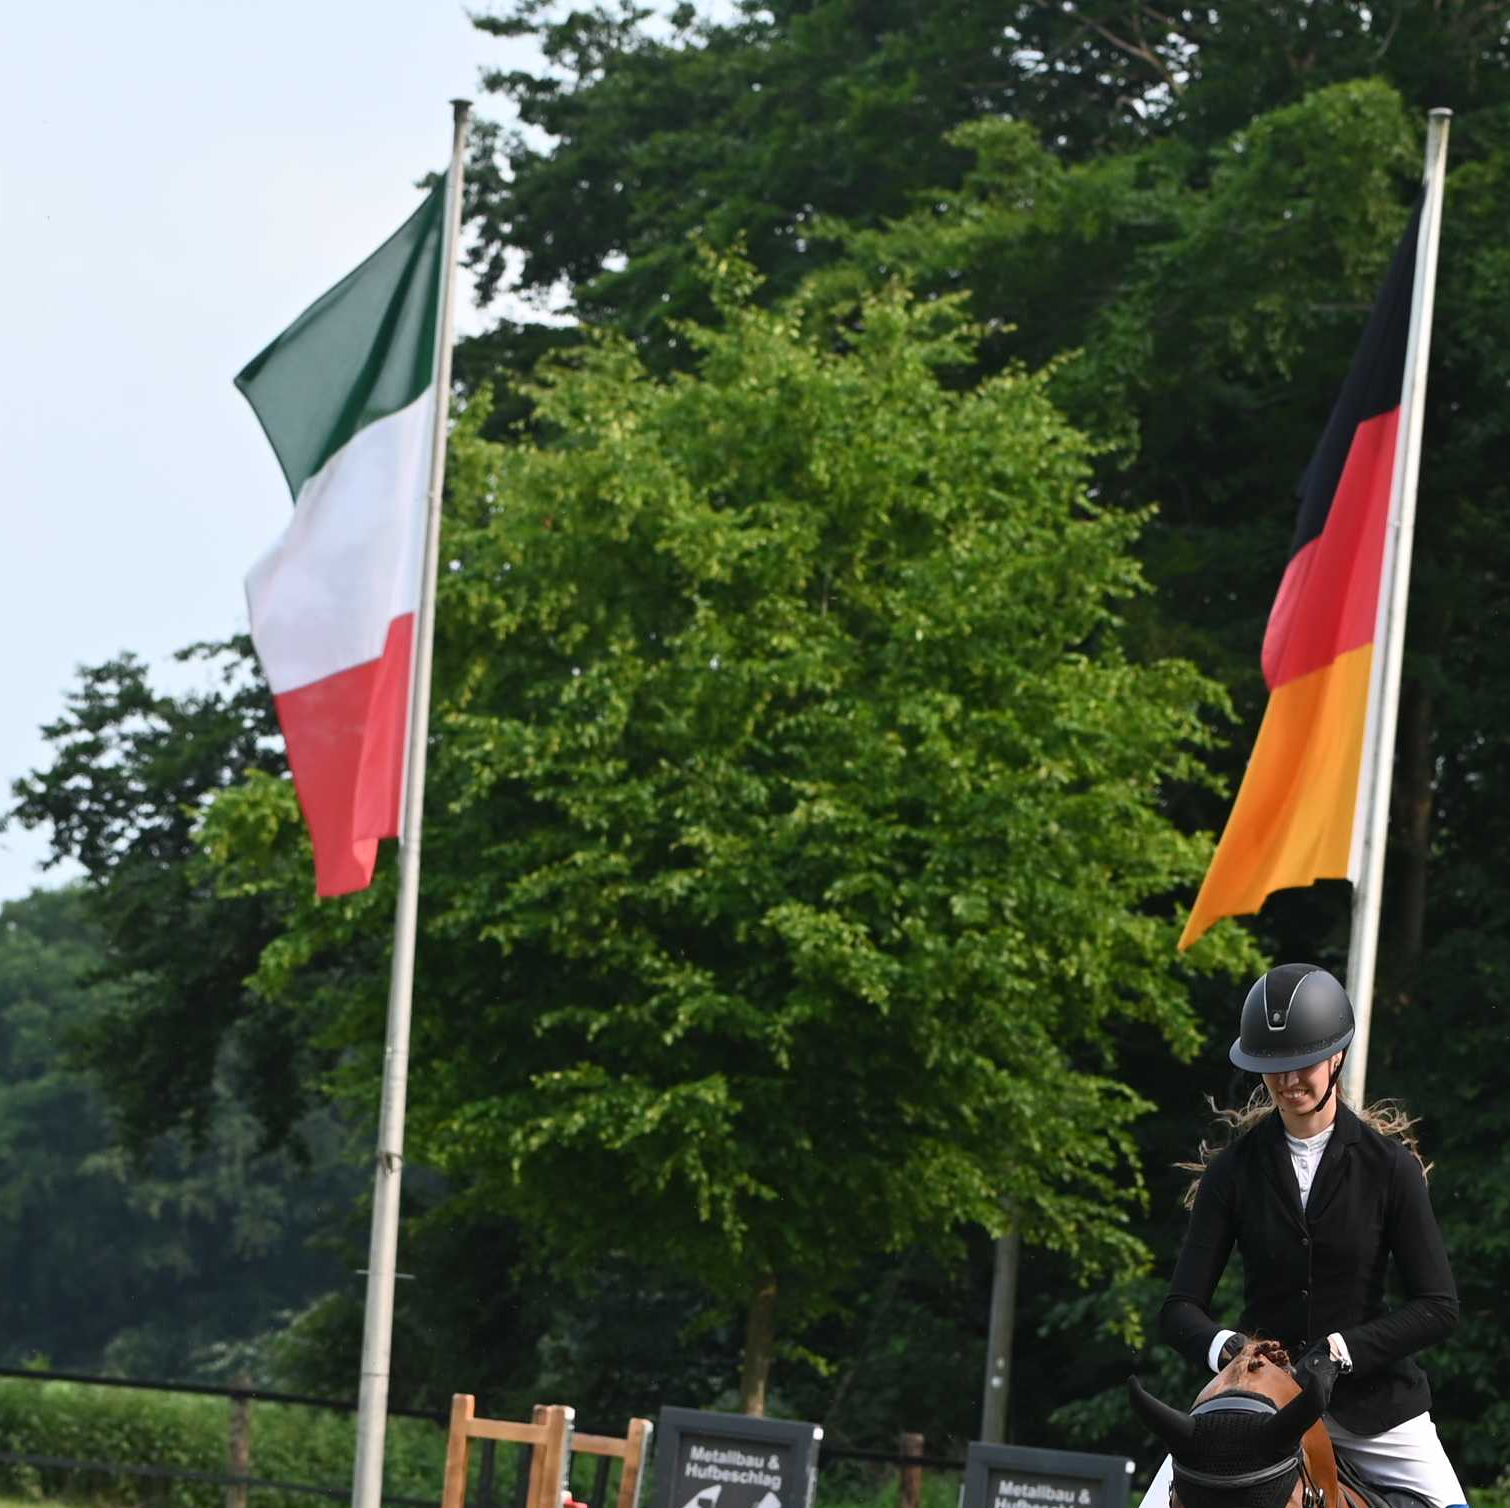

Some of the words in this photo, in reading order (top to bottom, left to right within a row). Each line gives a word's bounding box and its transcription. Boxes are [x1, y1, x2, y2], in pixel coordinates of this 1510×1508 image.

[690, 1445, 765, 1469] Metallbau
[767, 1455, 780, 1470] &
[684, 1463, 782, 1491] Hufbeschlag
[999, 1480, 1075, 1504] Metallbau
[1078, 1489, 1091, 1504] &
